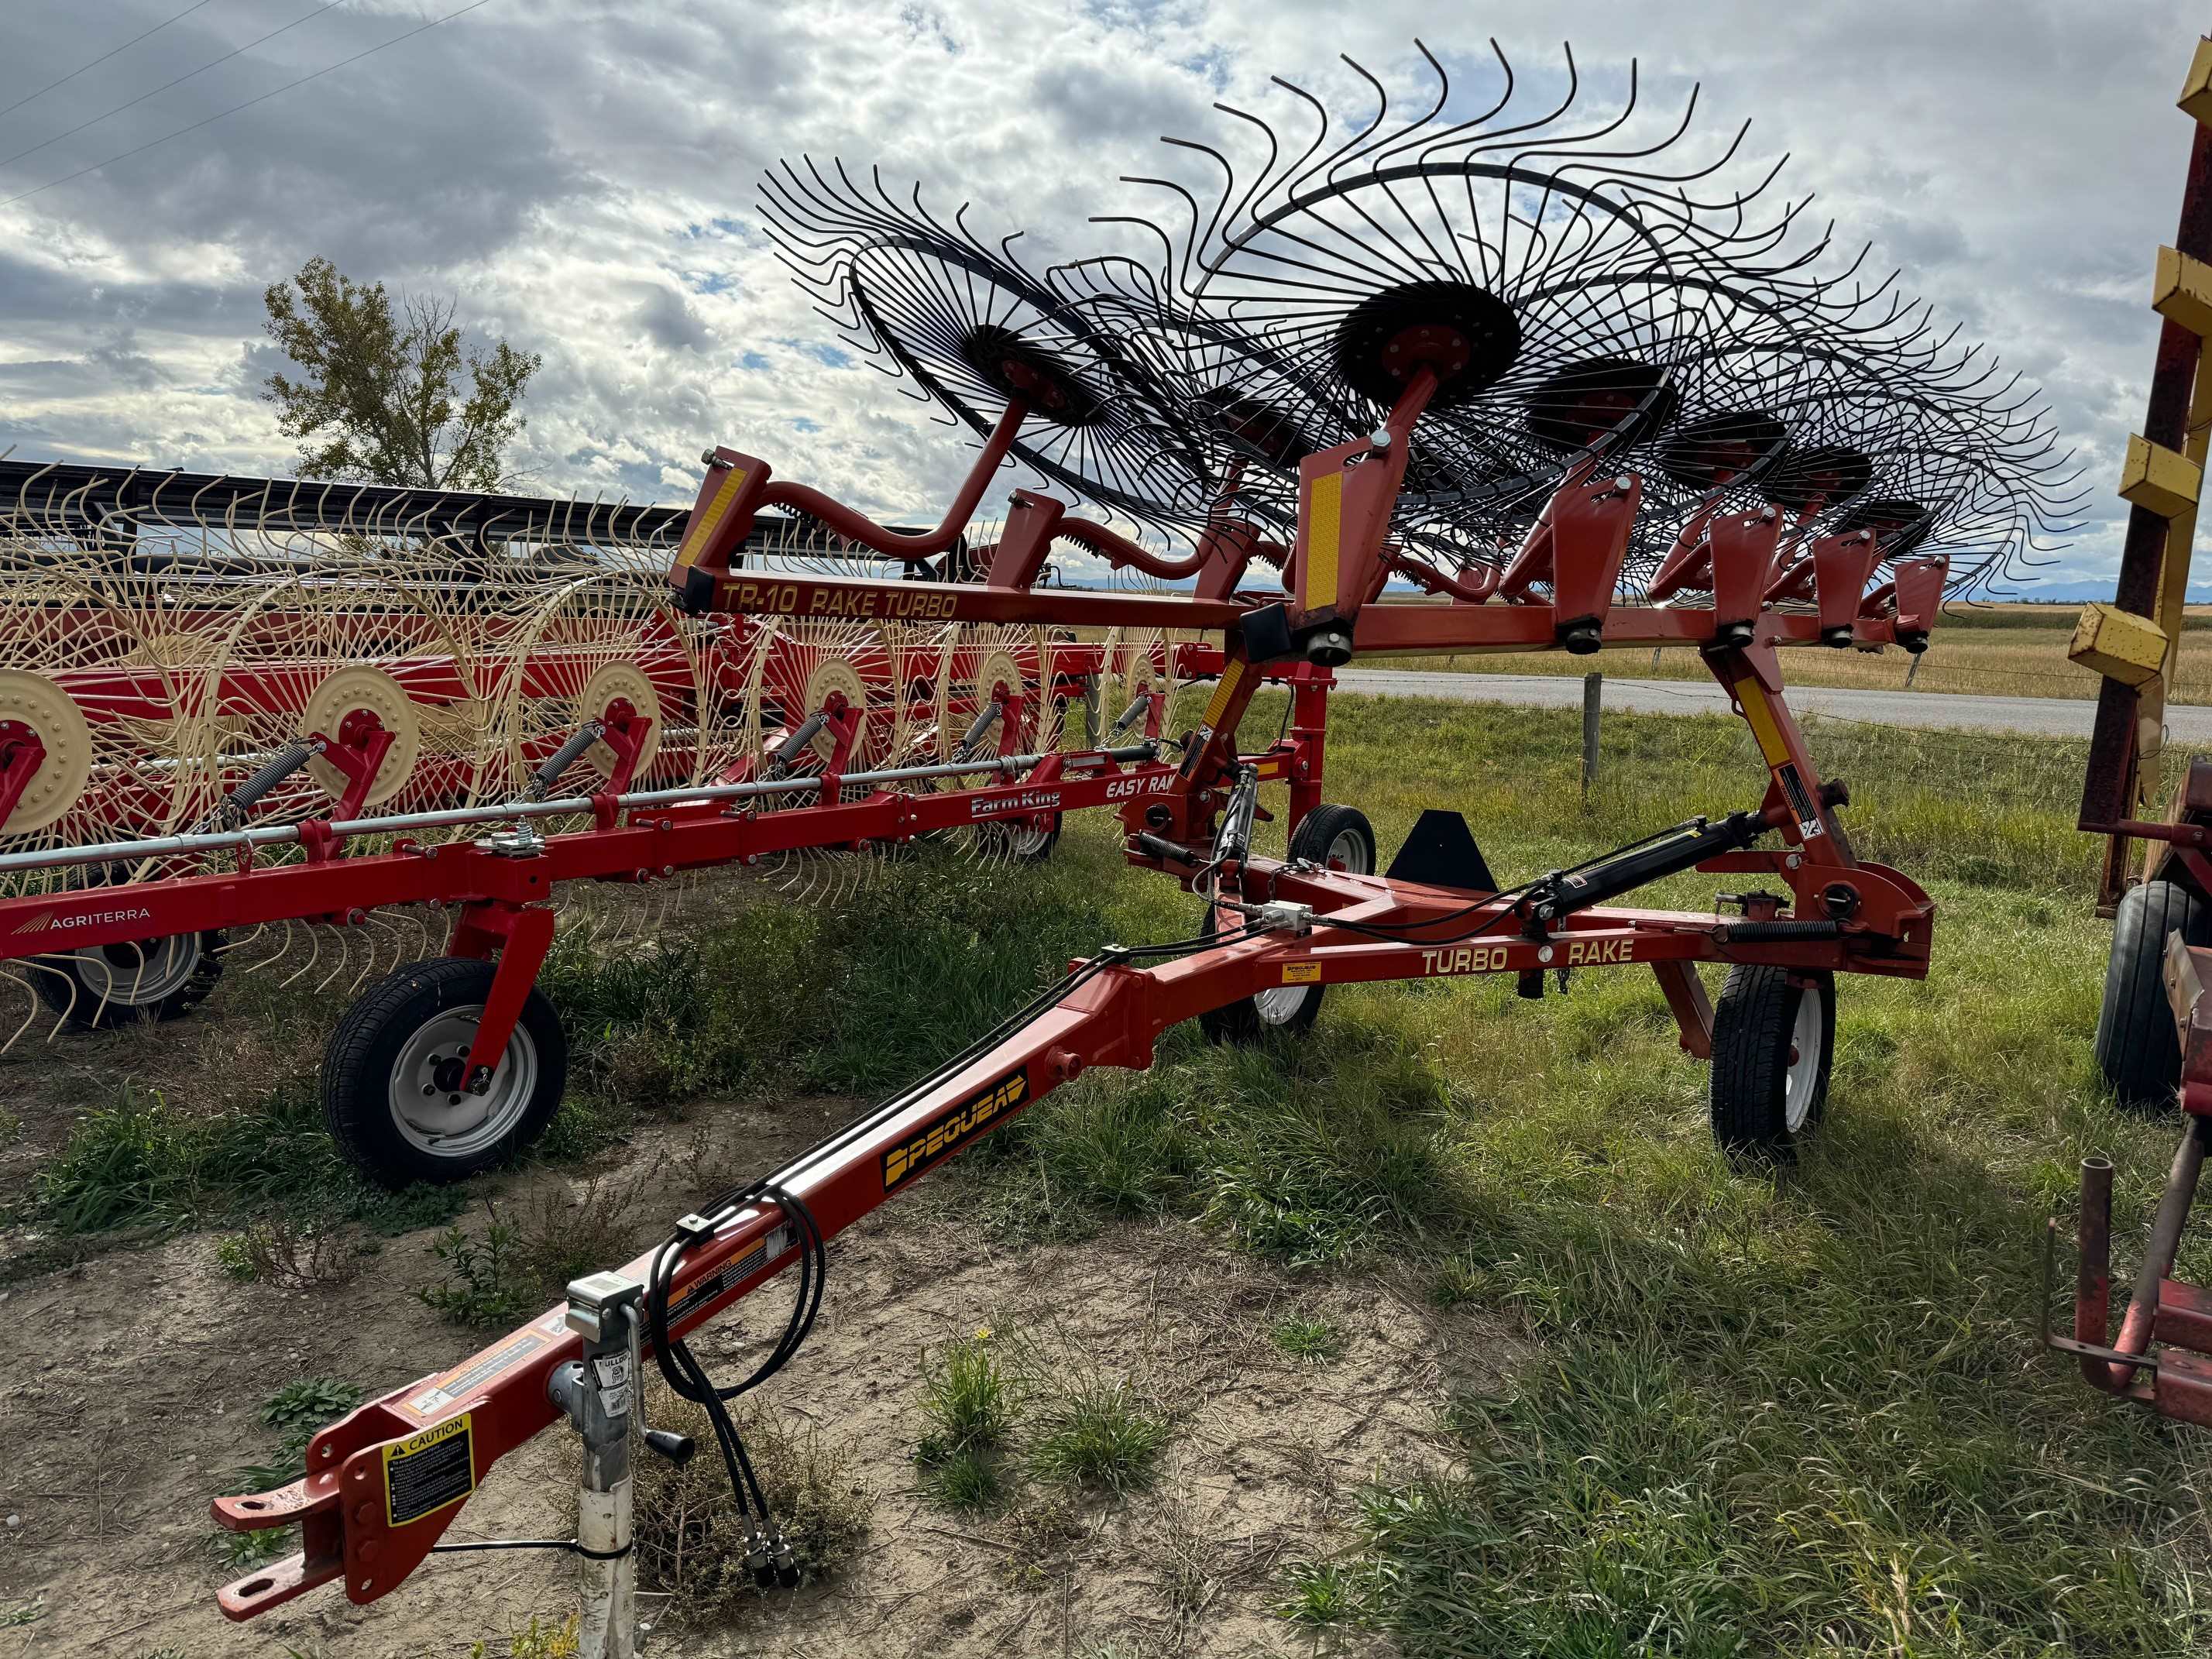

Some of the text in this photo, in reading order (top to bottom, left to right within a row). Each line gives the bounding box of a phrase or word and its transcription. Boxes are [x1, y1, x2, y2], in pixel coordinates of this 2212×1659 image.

[722, 582, 958, 619] TR-10 RAKE TURBO
[971, 790, 1061, 814] Farm King
[1106, 778, 1146, 799] EASY
[50, 908, 151, 930] AGRITERRA
[1421, 938, 1634, 974] TURBO RAKE
[694, 1259, 732, 1288] WARNING
[409, 1418, 463, 1451] CAUTION
